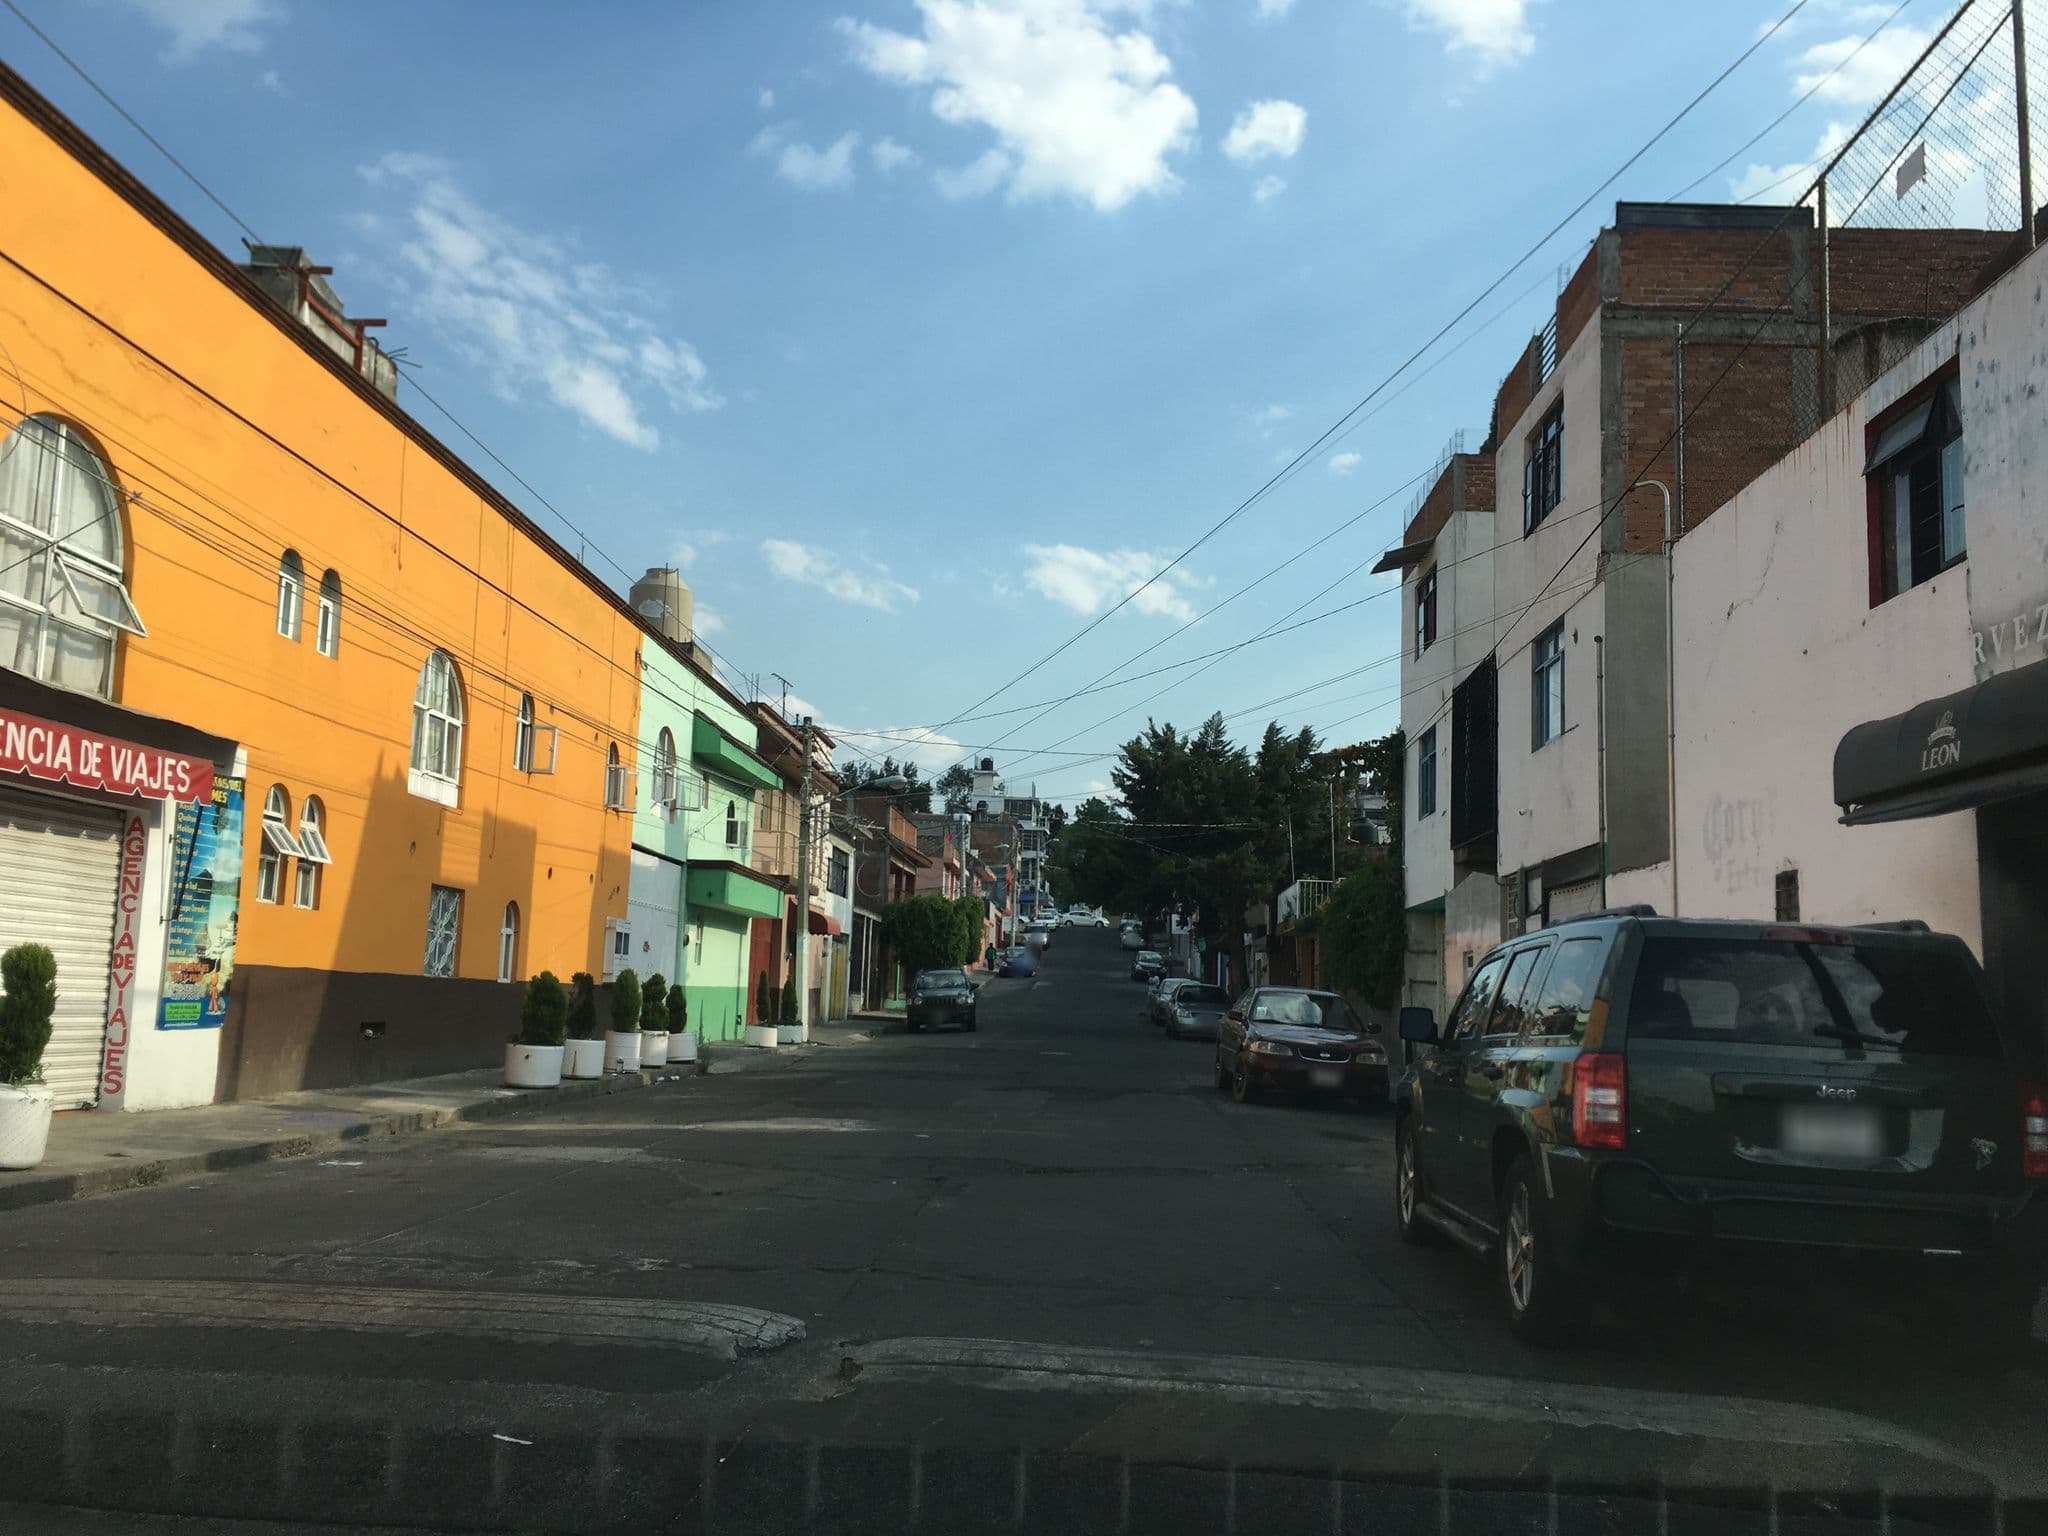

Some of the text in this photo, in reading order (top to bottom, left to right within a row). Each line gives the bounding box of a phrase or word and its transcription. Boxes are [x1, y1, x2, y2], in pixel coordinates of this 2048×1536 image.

[79, 739, 104, 778] DE
[110, 745, 191, 793] VIAJES
[1921, 740, 1961, 772] LEON
[103, 815, 145, 1094] AGENCIA DE VIAJES
[1816, 1085, 1857, 1101] Jeep
